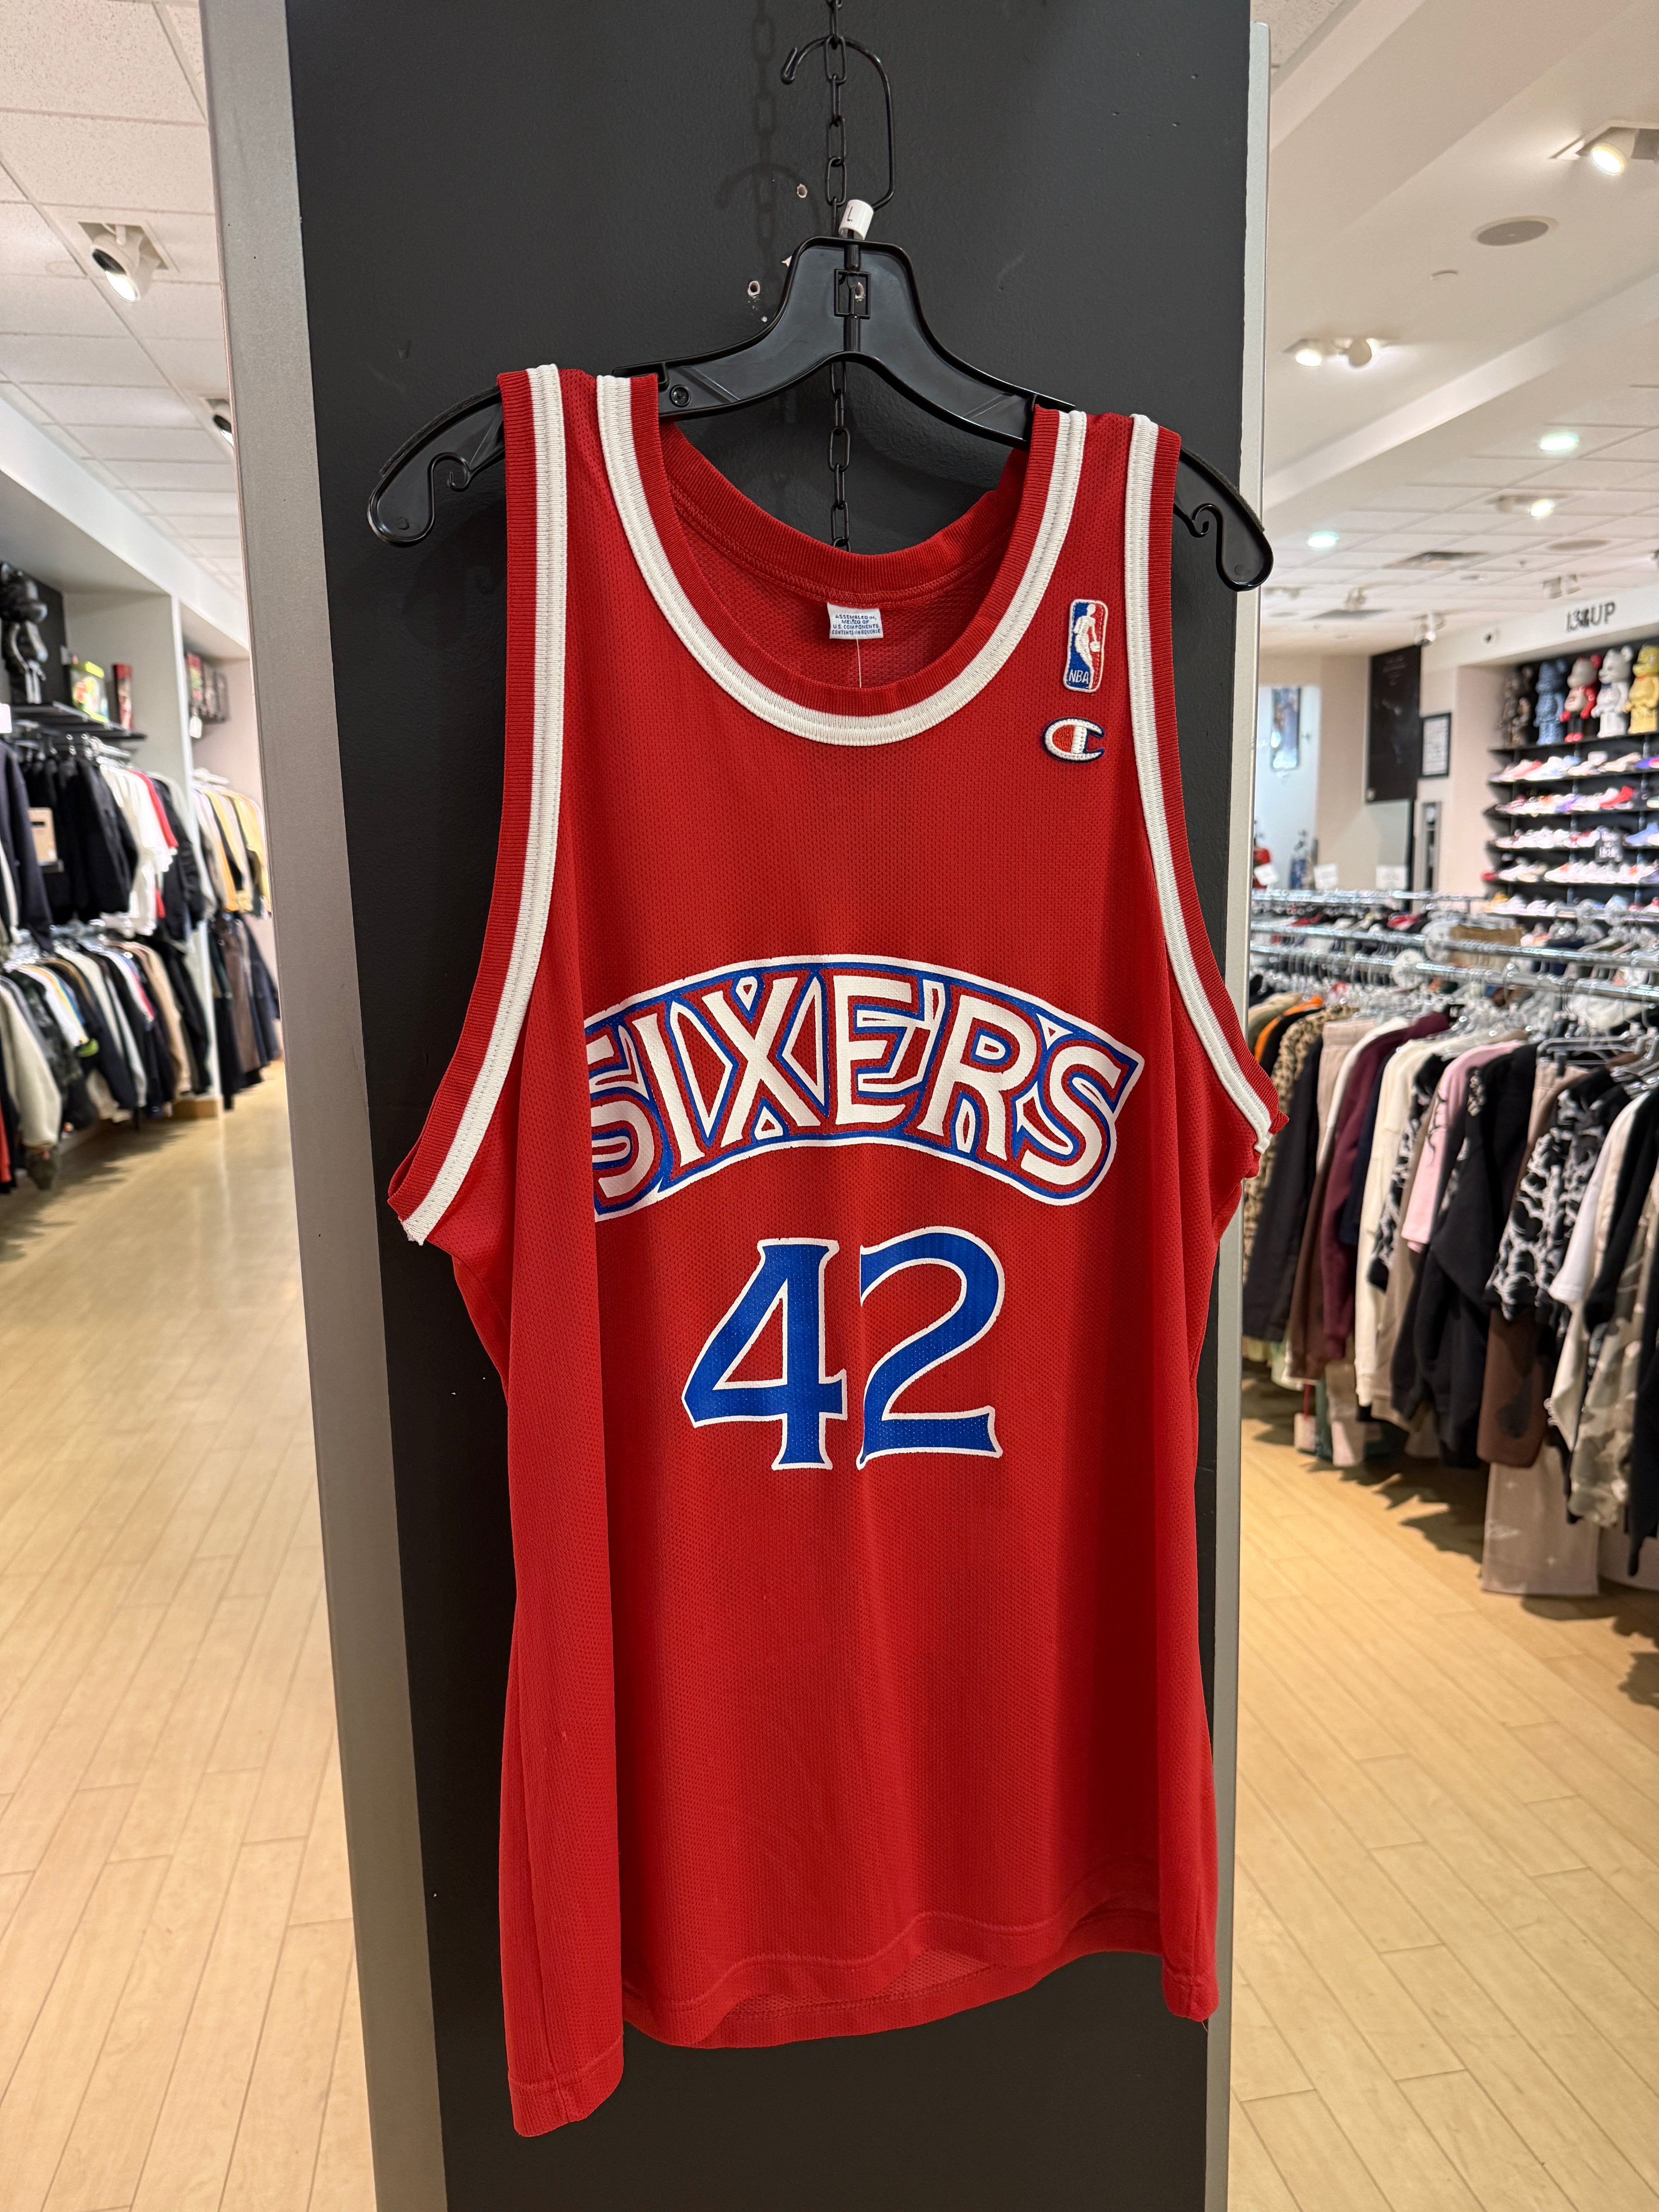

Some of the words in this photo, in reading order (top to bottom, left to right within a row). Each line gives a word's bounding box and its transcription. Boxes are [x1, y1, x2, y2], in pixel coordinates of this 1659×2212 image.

[1068, 669, 1089, 684] NBA
[585, 968, 1129, 1204] SIXERS
[682, 1226, 1006, 1471] 42
